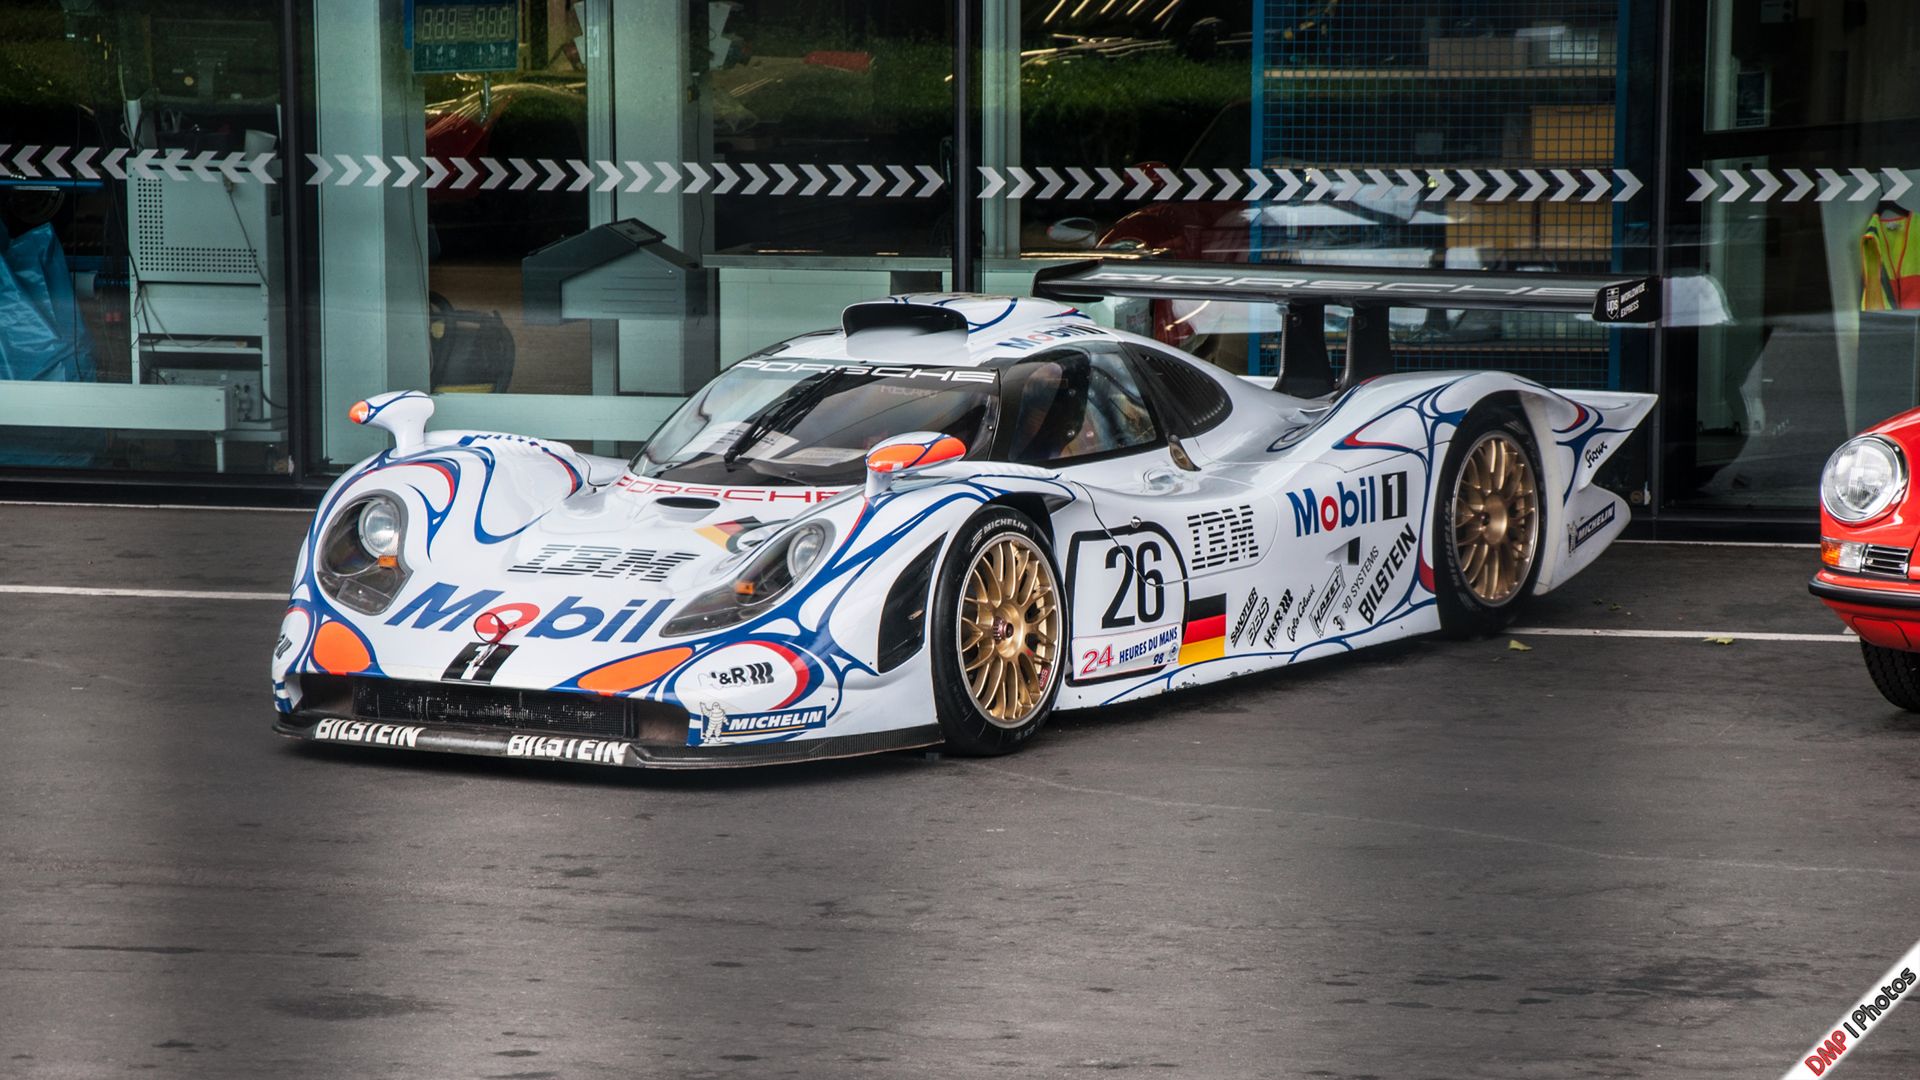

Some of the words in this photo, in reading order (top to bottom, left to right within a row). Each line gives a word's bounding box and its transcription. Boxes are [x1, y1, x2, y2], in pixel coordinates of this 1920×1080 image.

[1082, 273, 1599, 298] PORSCHE
[734, 360, 997, 384] PORSCHE
[983, 518, 1029, 535] MICHELIN
[1286, 475, 1376, 538] Mobil
[1385, 473, 1403, 518] 1
[1186, 504, 1259, 571] IBM
[507, 544, 702, 582] IBM
[1102, 541, 1165, 629] 26
[1351, 545, 1379, 598] SYSTEMS
[1358, 522, 1417, 625] BILSTEIN
[384, 582, 675, 643] Mobil
[1313, 575, 1342, 630] HAZET
[1080, 644, 1115, 677] 24
[1119, 641, 1148, 664] HEURES
[1149, 636, 1158, 652] DU
[1159, 626, 1178, 646] MANS
[1153, 652, 1165, 666] 98
[315, 718, 427, 748] BILSTEIN
[728, 710, 824, 731] MICHELIN
[507, 735, 632, 765] BILSTEIN
